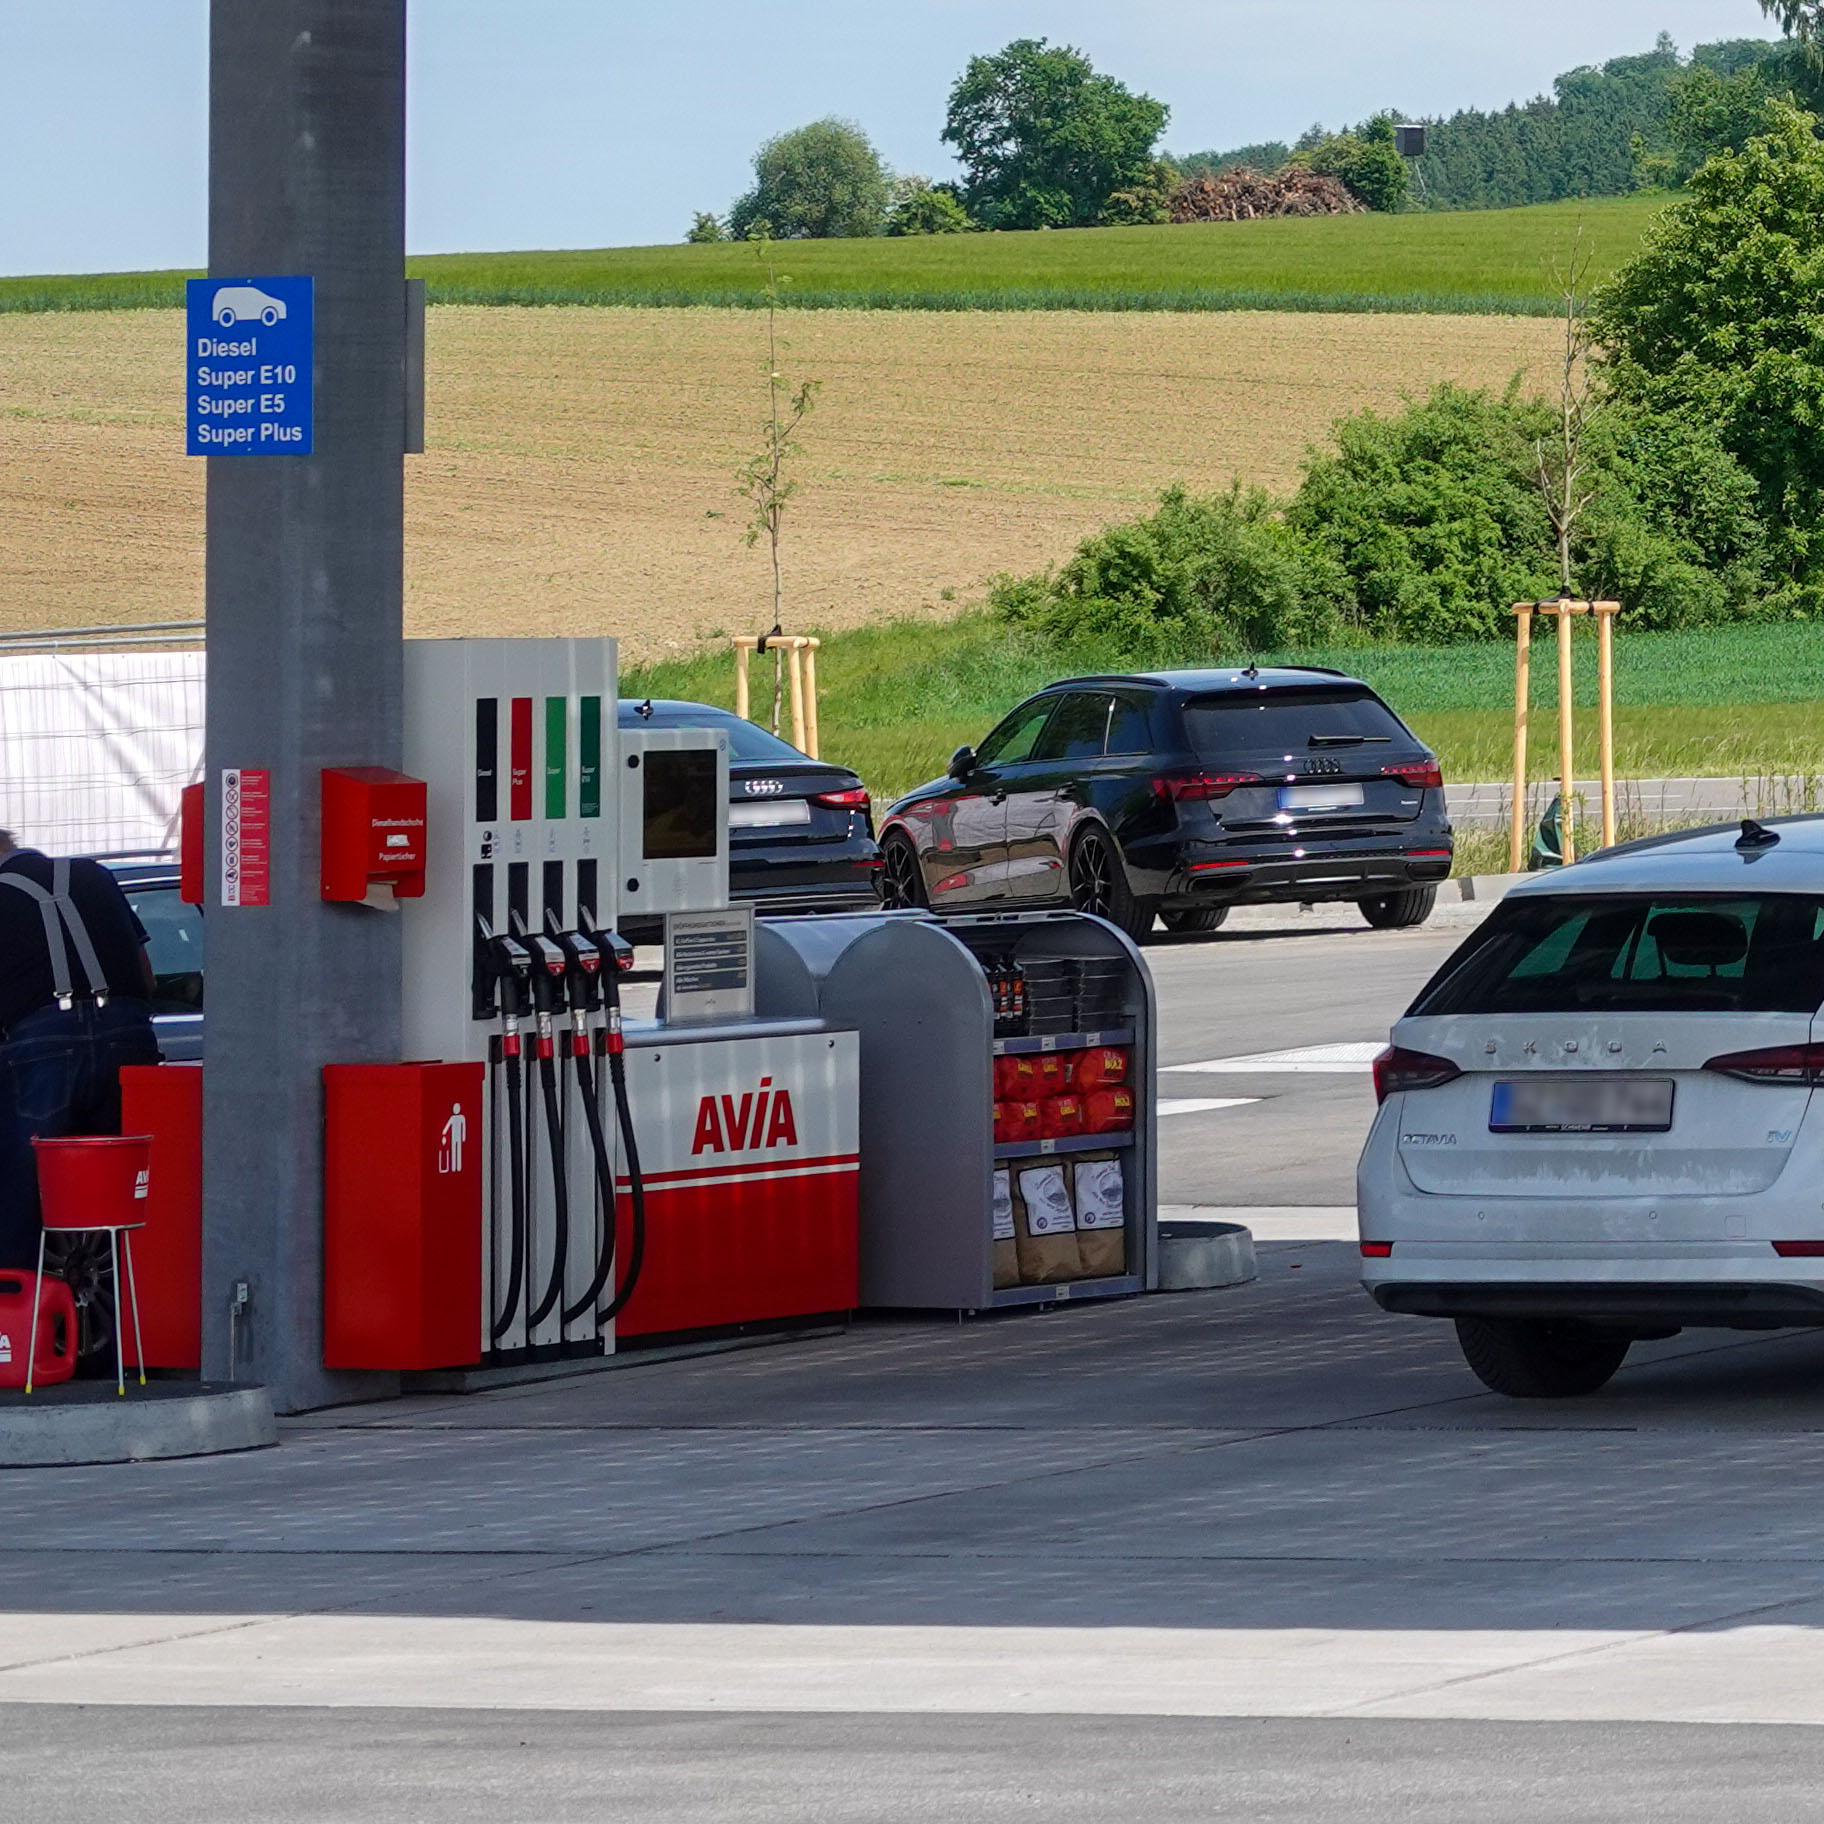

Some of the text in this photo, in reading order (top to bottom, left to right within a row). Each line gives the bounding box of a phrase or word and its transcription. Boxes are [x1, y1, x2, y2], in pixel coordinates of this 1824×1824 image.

[197, 336, 257, 357] Diesel
[197, 364, 296, 390] Super E10
[197, 393, 286, 418] Super E5
[197, 422, 303, 447] Super Plus
